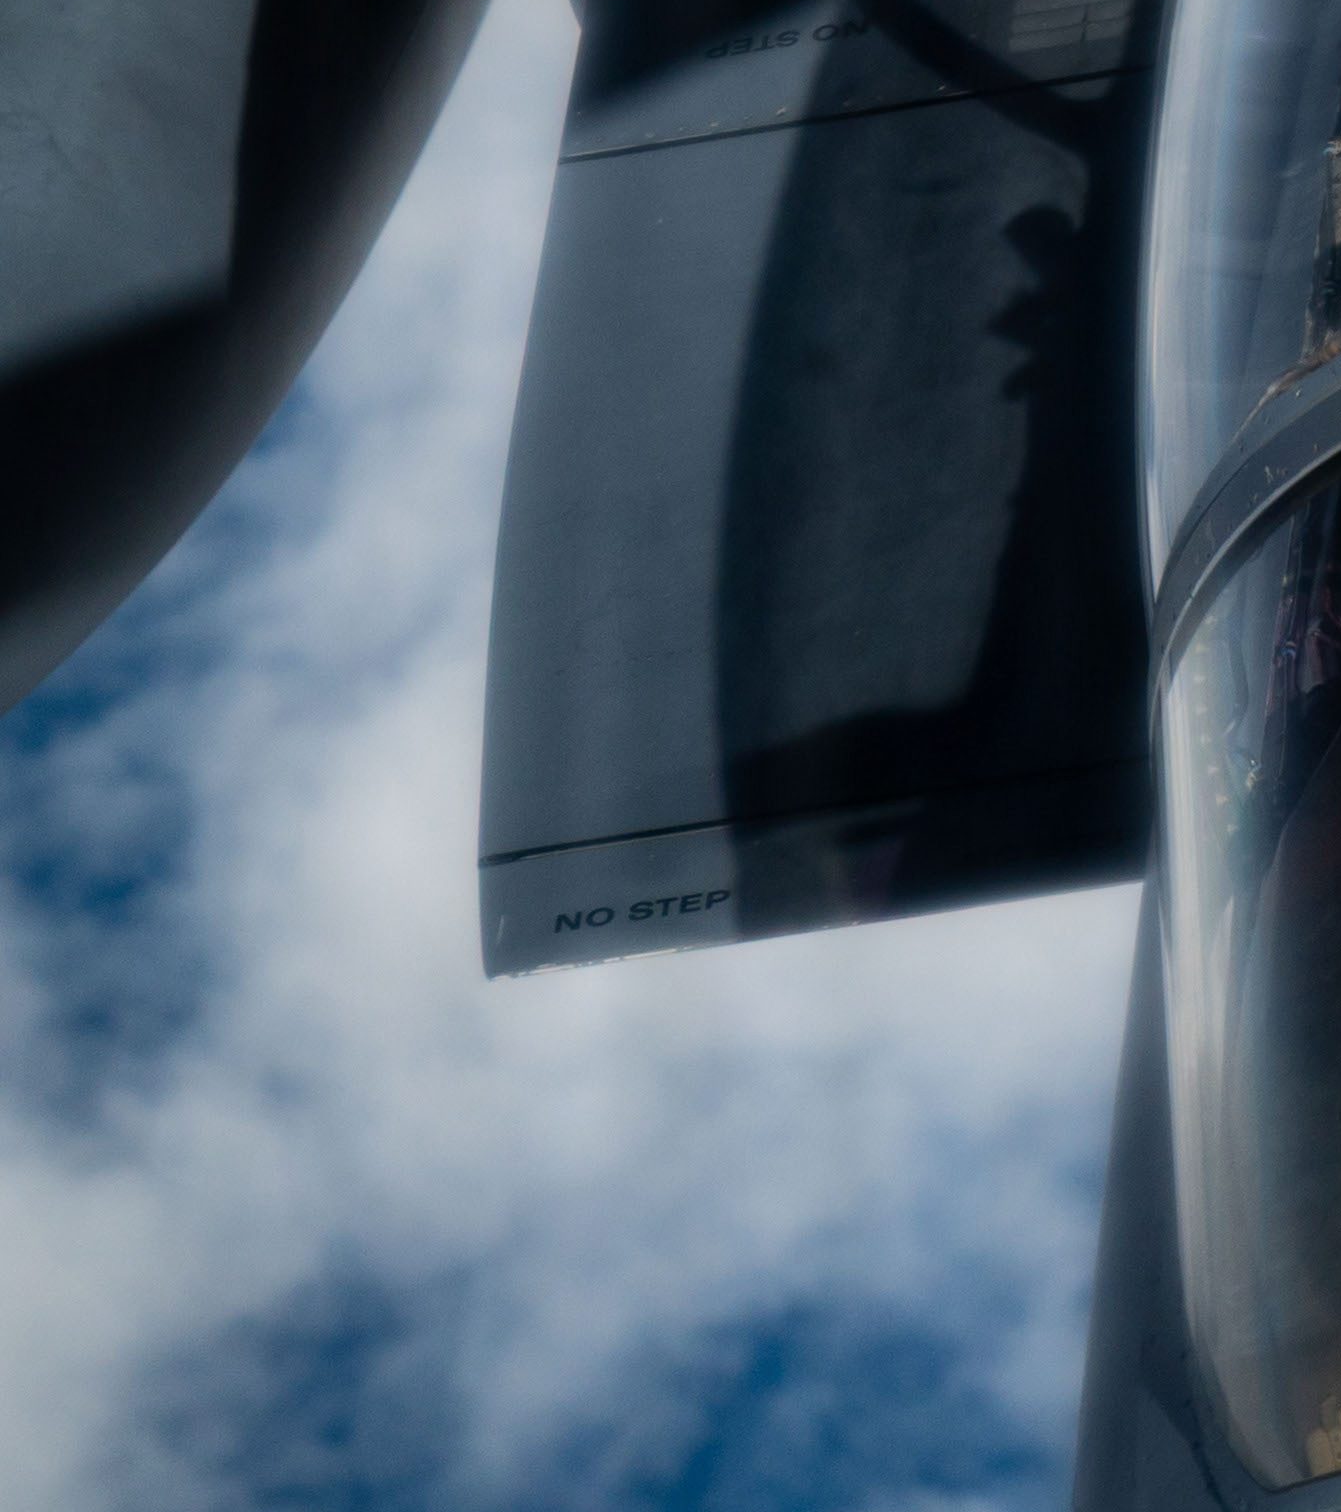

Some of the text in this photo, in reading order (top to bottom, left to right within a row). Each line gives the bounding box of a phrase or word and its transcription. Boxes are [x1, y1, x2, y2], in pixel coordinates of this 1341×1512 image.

[705, 30, 800, 59] STEP
[553, 888, 732, 934] NO STEP
